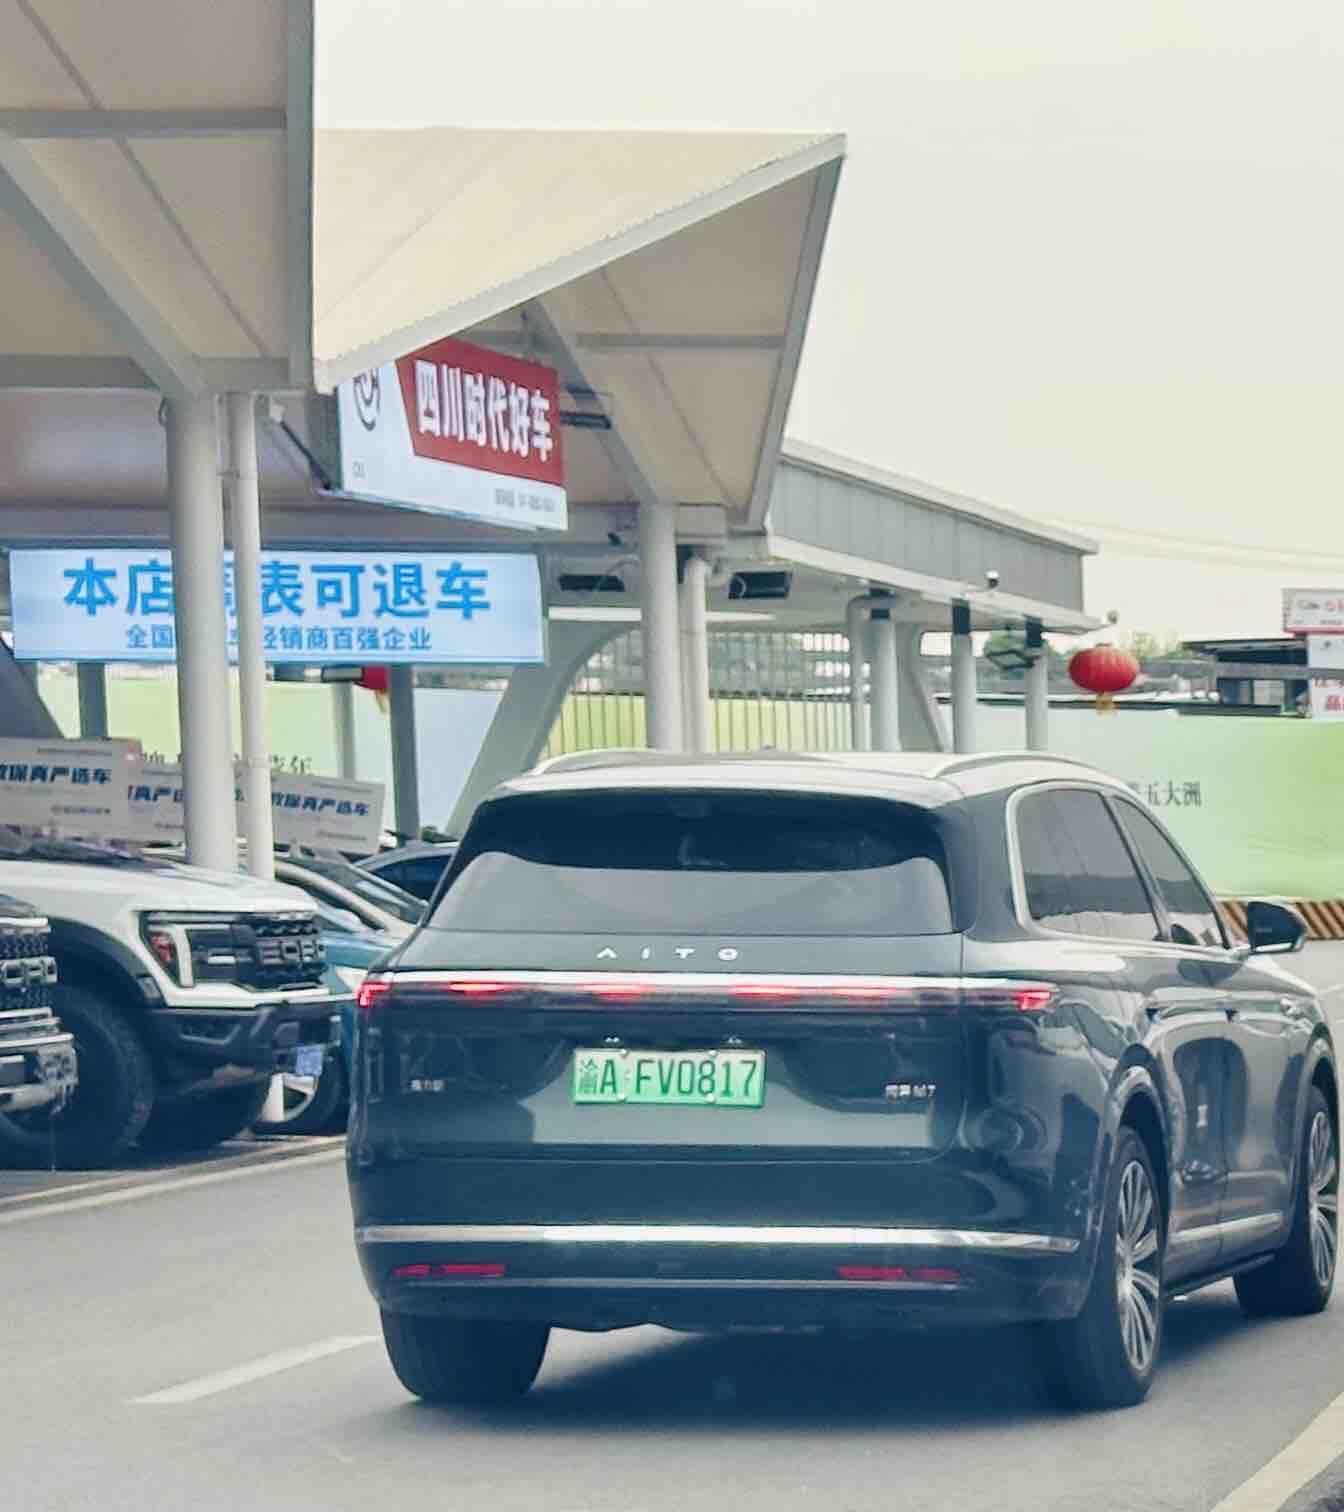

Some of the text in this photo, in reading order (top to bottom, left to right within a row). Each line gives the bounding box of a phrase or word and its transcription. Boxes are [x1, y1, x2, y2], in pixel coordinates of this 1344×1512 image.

[415, 359, 553, 463] 四川时代好车
[63, 556, 492, 620] 本店表可退车
[125, 623, 432, 651] 全国经销商百强企业
[597, 947, 739, 961] AITO
